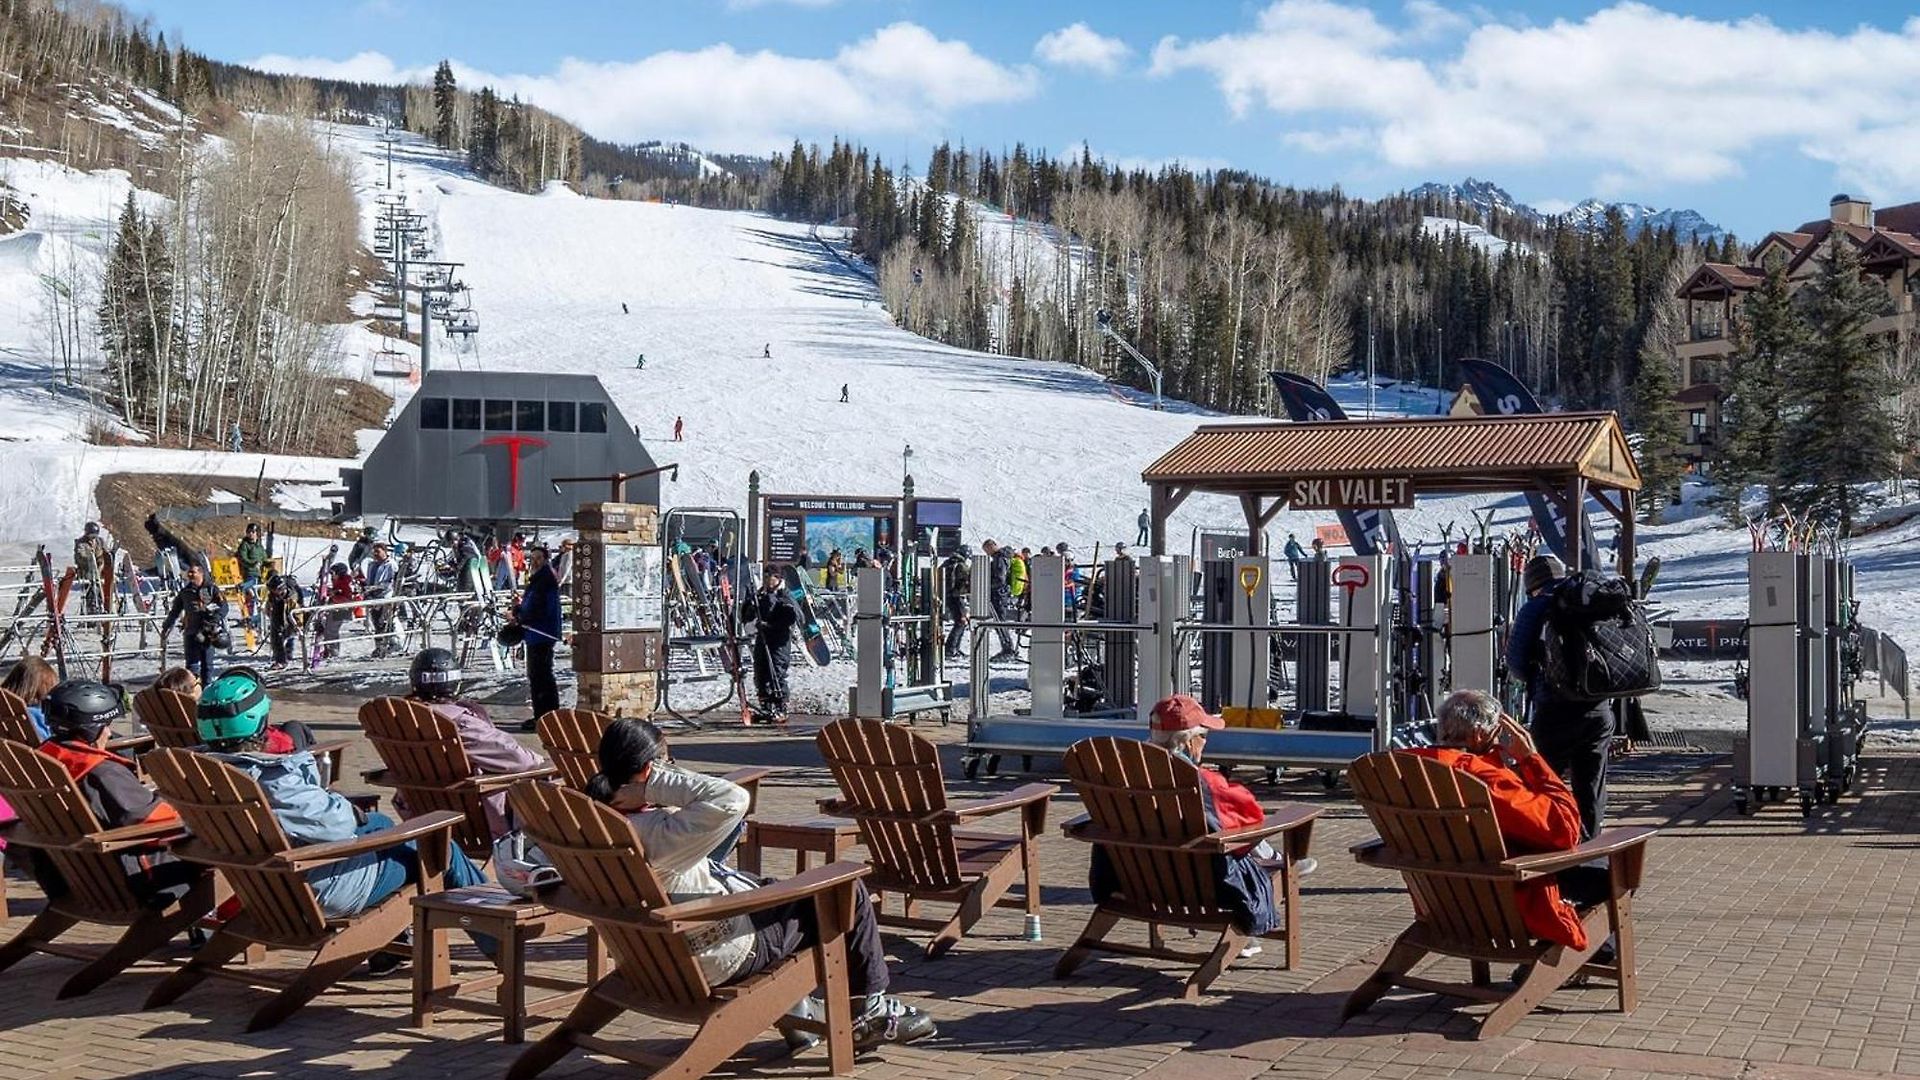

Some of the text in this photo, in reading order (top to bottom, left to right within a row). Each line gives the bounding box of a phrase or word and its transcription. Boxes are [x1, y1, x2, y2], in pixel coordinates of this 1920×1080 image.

[1294, 478, 1409, 506] SKI VALET
[799, 501, 826, 509] WELCOME
[836, 502, 866, 510] TELLURIDE
[92, 708, 119, 721] SMITH
